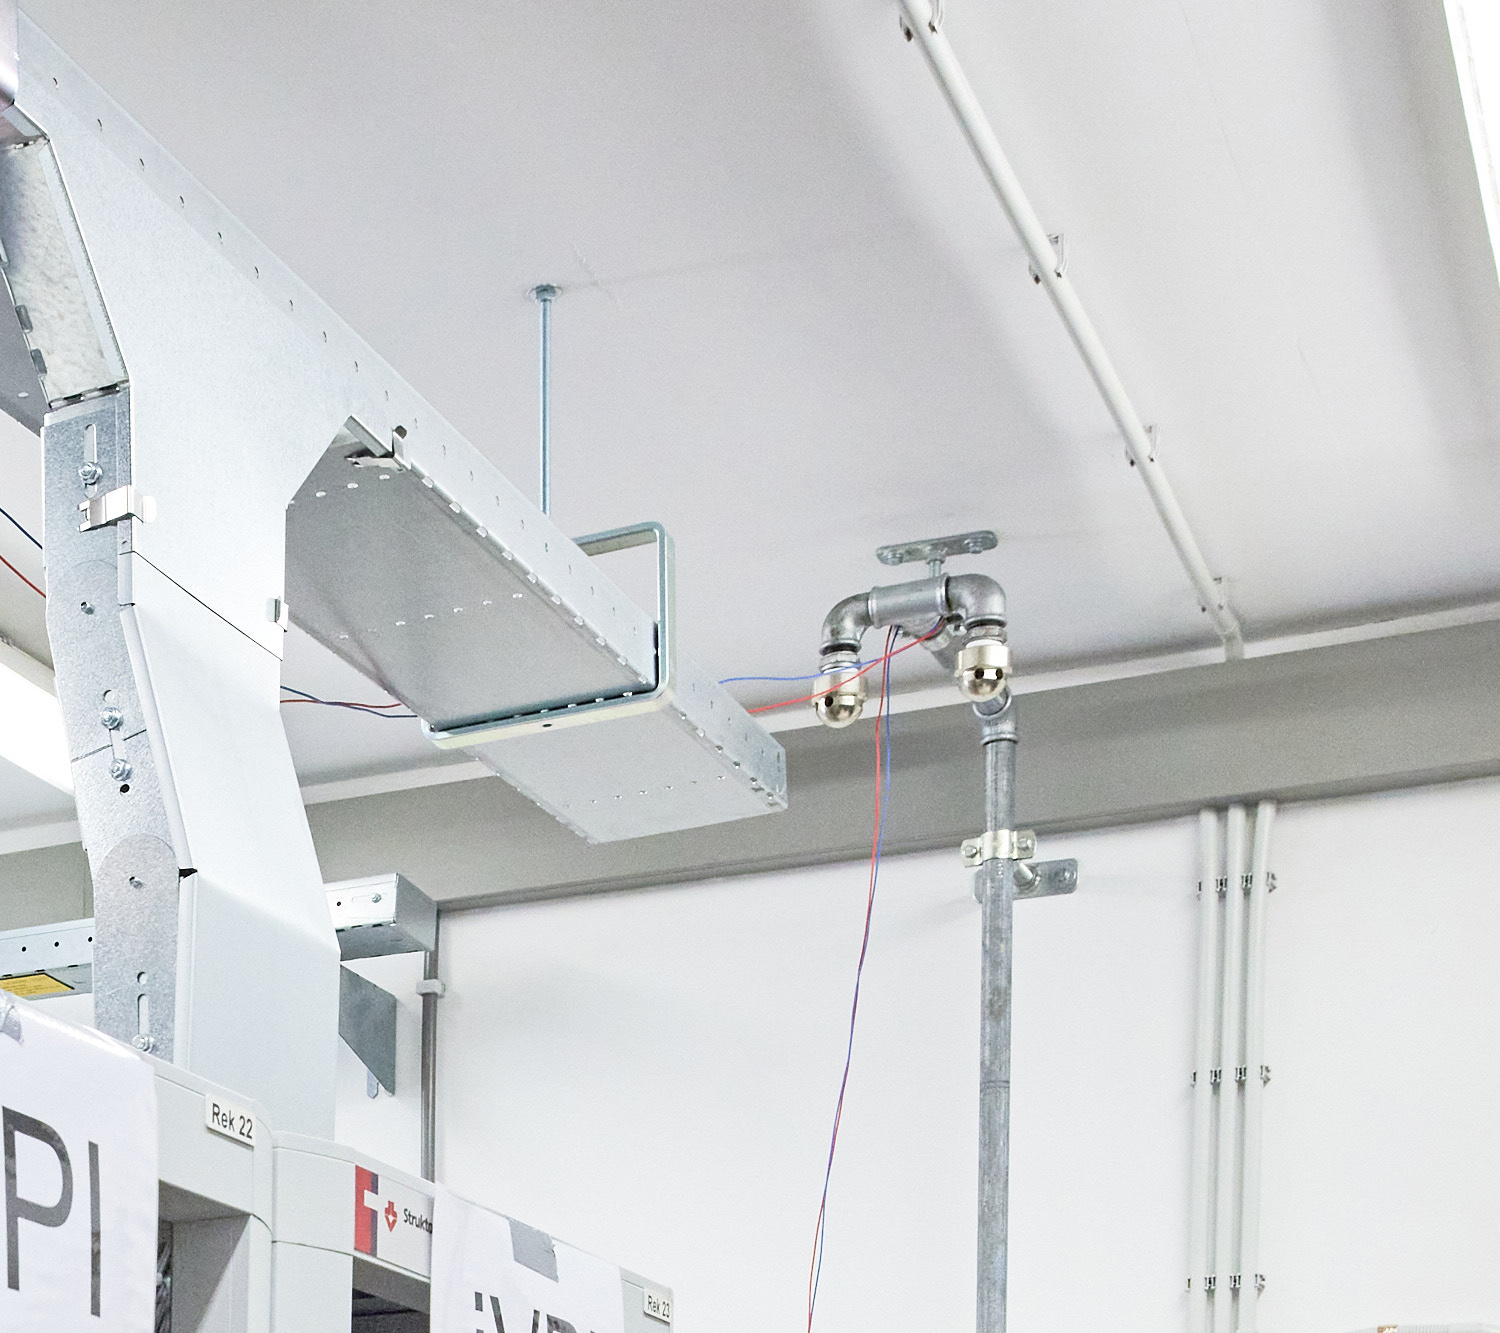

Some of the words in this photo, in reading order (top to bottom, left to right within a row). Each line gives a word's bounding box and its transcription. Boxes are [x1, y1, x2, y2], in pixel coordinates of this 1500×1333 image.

[211, 1103, 235, 1132] Rek
[239, 1116, 254, 1140] 22
[647, 1296, 661, 1315] Rek
[661, 1301, 672, 1319] 23
